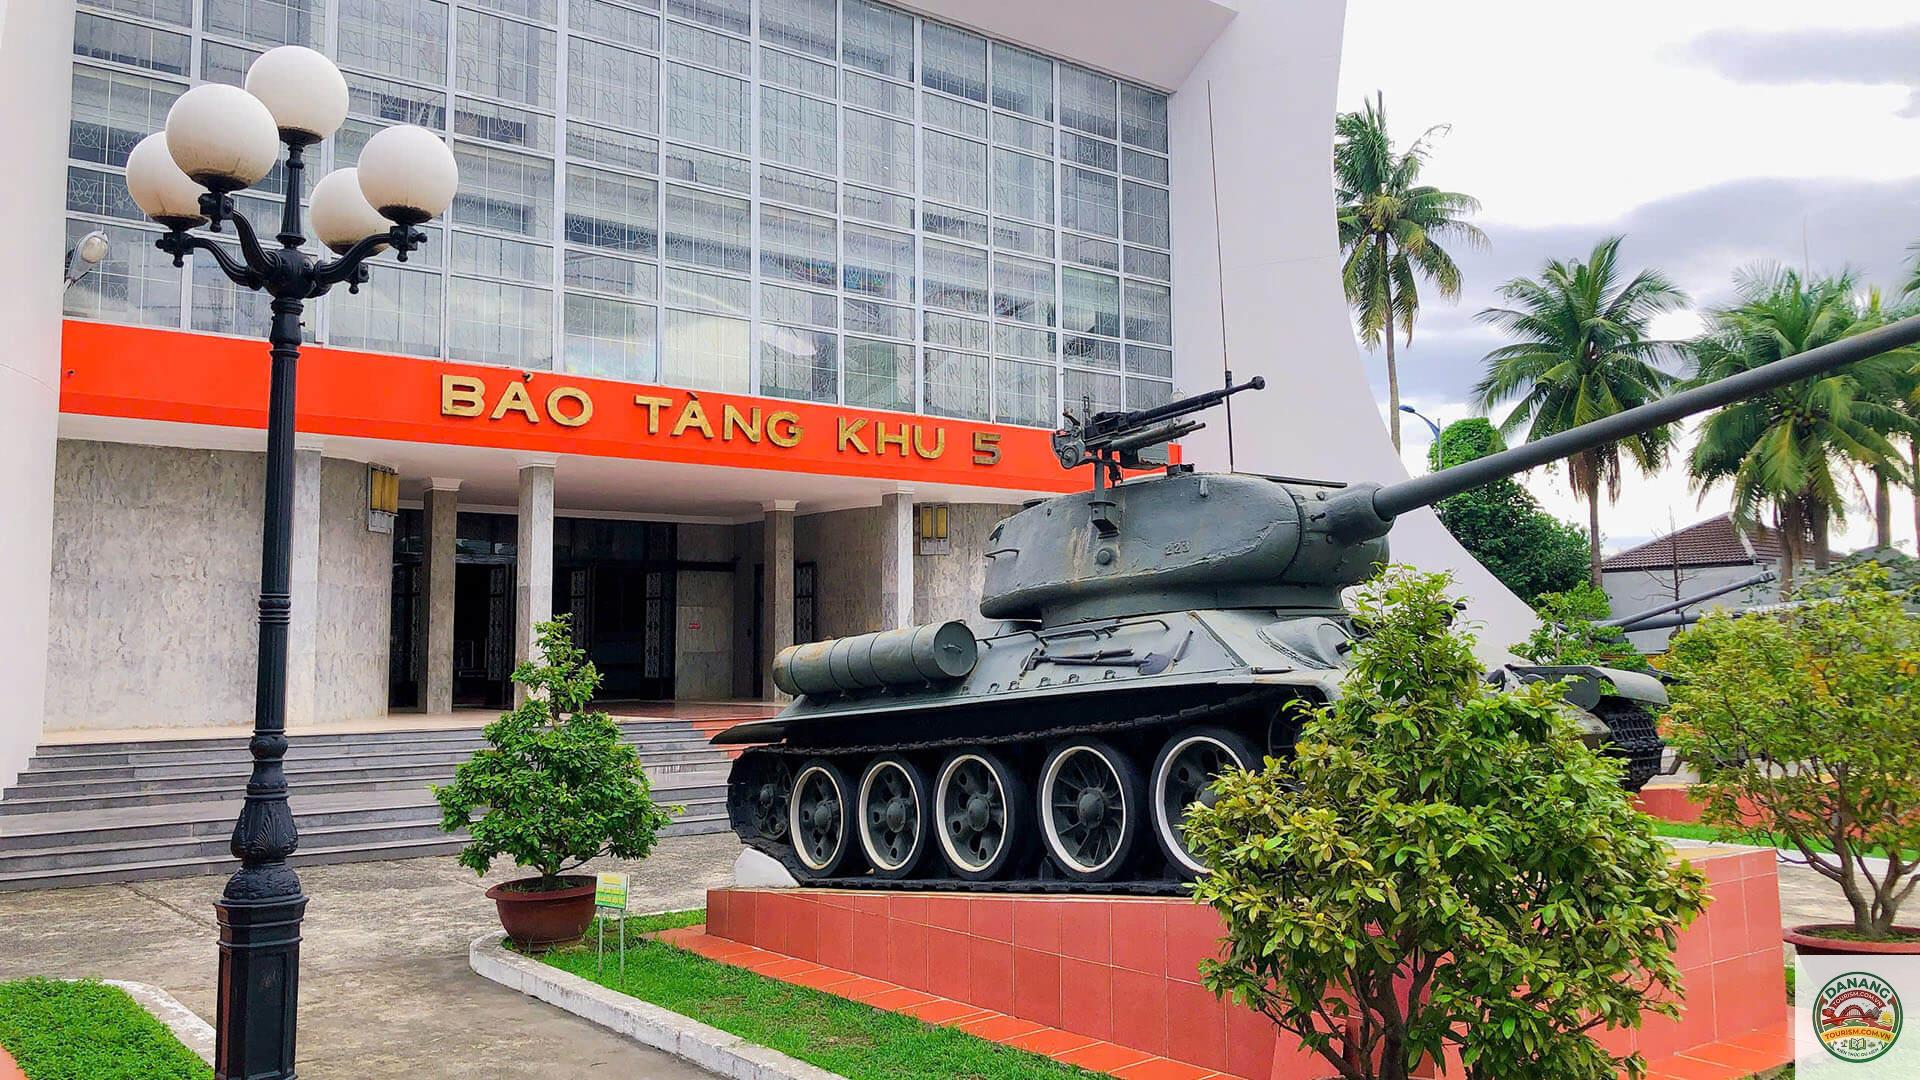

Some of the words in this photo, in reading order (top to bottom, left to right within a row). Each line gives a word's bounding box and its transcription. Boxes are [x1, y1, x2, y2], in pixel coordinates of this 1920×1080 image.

[440, 372, 594, 427] BẢO
[635, 391, 804, 448] TÀNG
[838, 416, 946, 459] KHU
[972, 431, 1003, 465] 5
